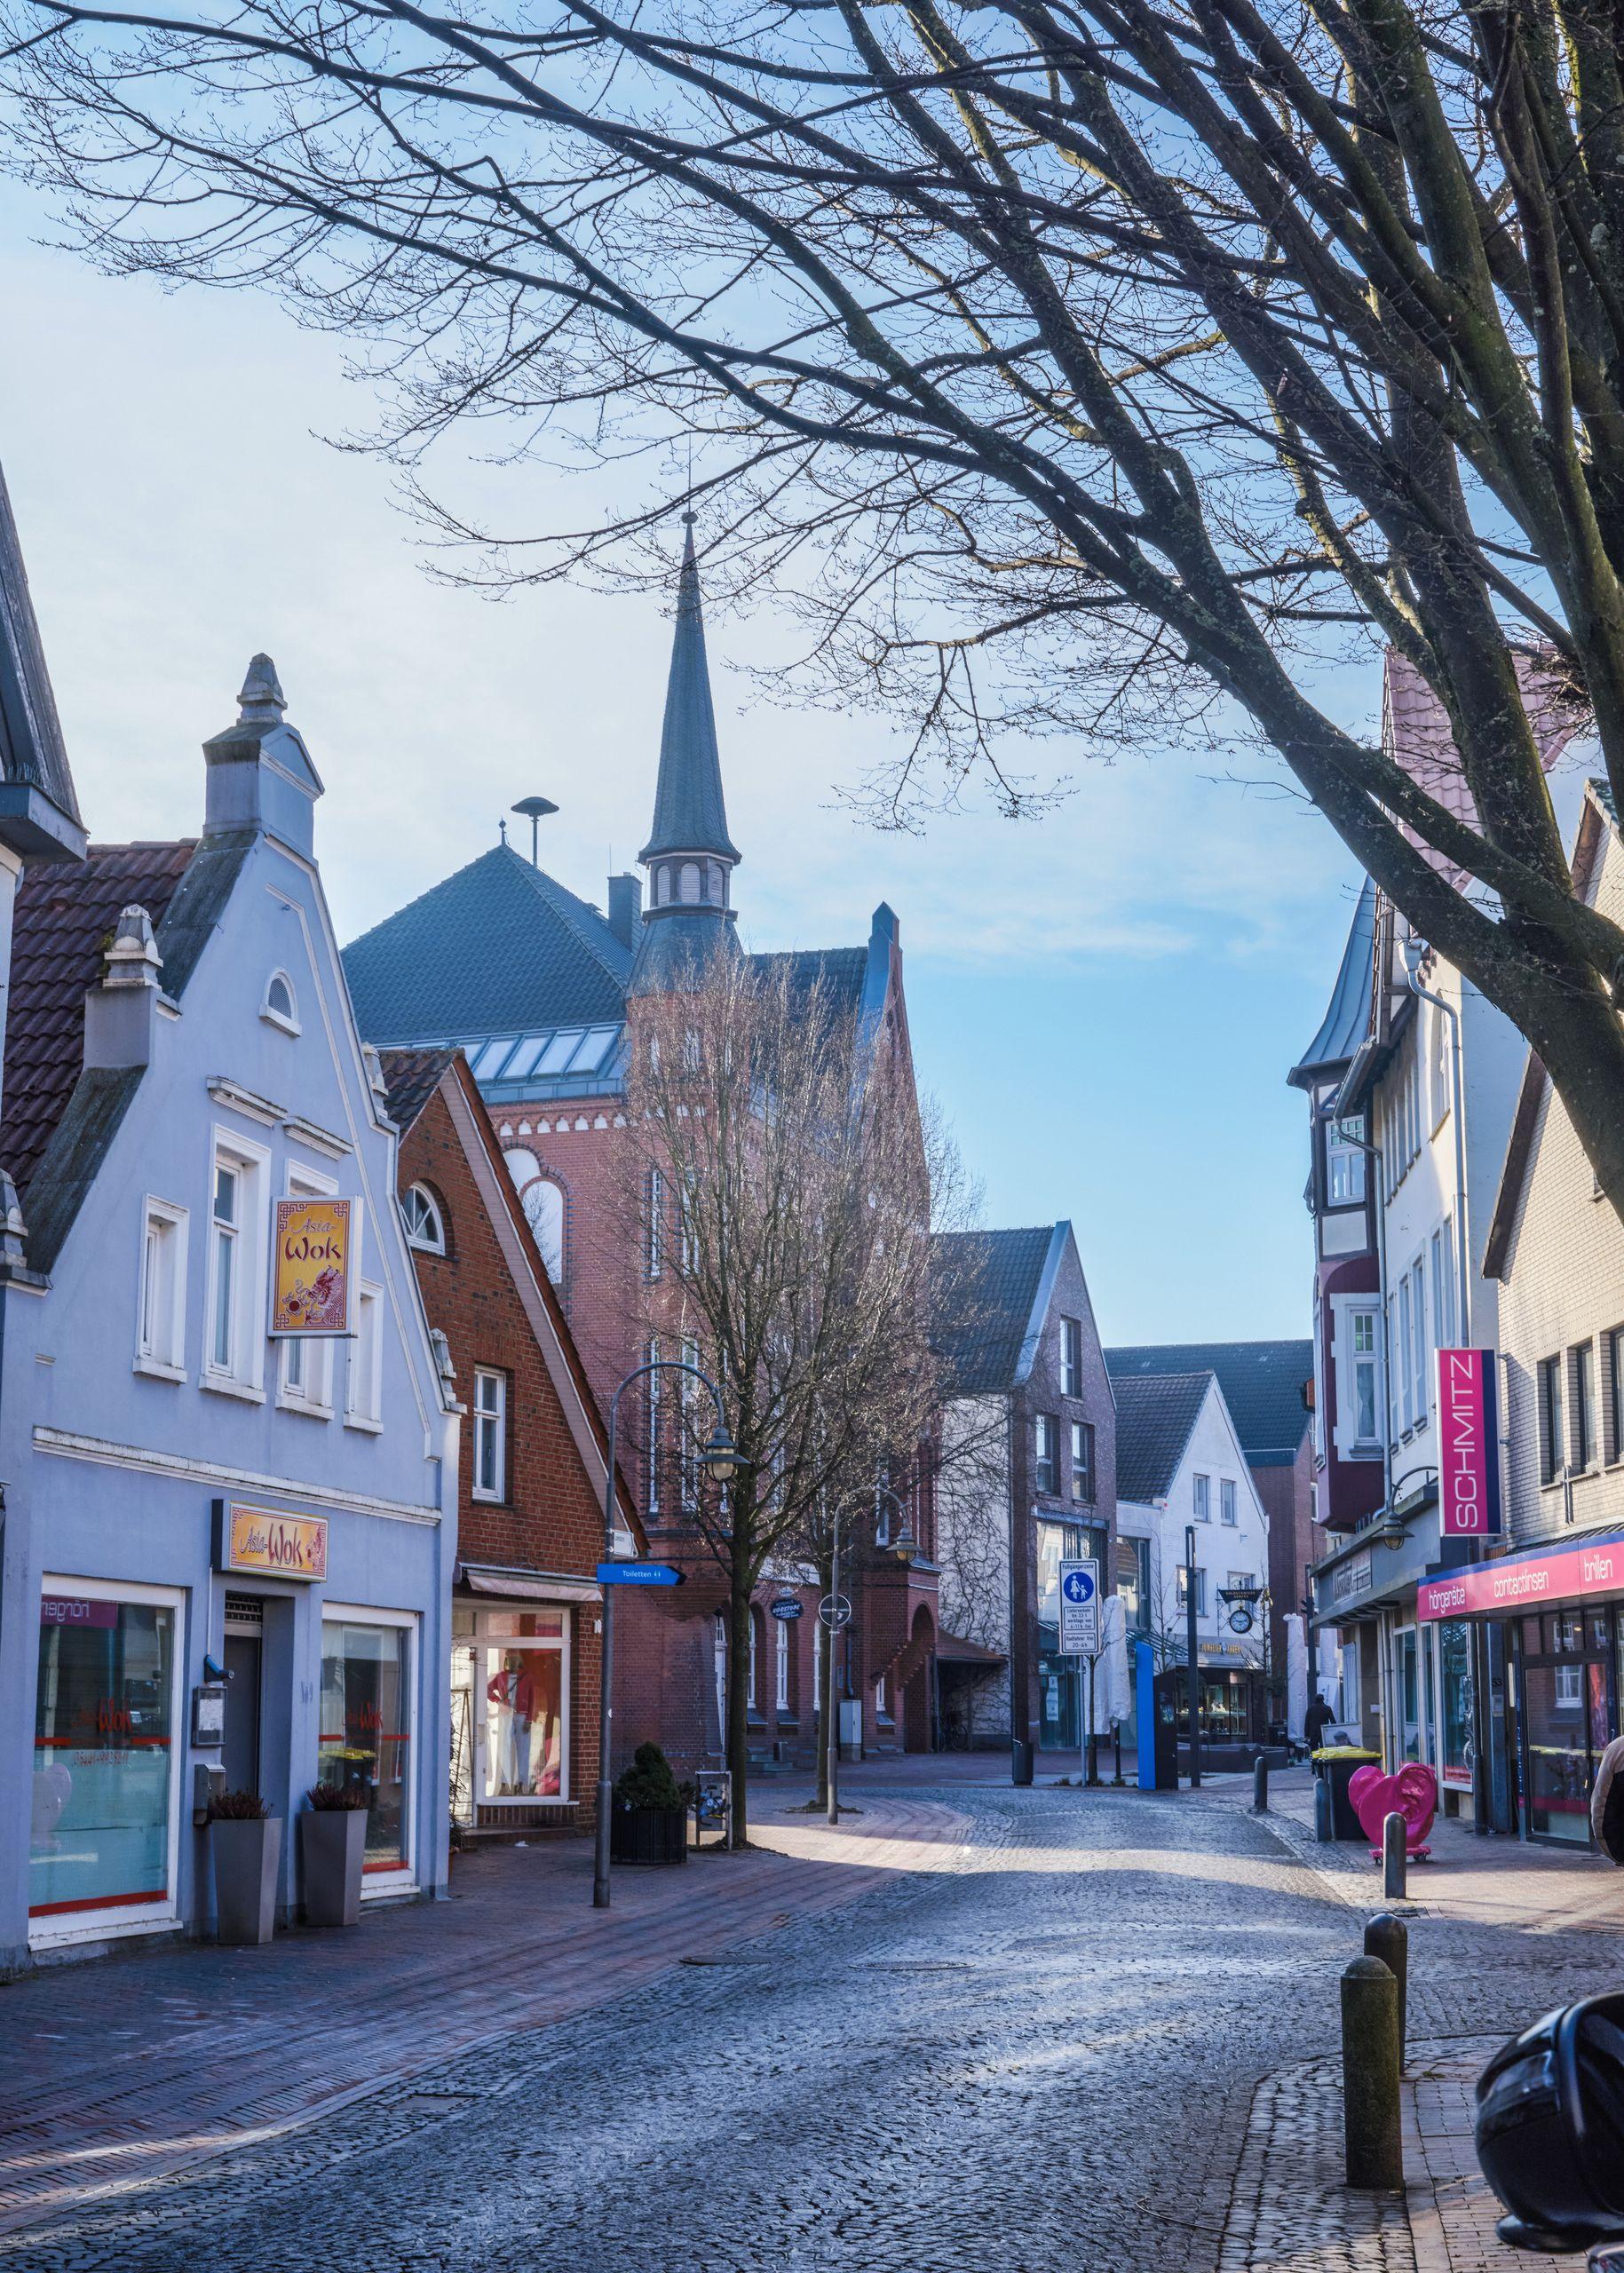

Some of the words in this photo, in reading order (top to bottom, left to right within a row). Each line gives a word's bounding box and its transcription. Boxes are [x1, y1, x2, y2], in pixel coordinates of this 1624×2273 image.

[284, 1236, 342, 1261] Wok
[1449, 1354, 1478, 1528] SCHMITZ
[1583, 1554, 1613, 1582] brillen
[1493, 1568, 1549, 1598] contactlinsen
[1429, 1586, 1465, 1614] hörgeräte
